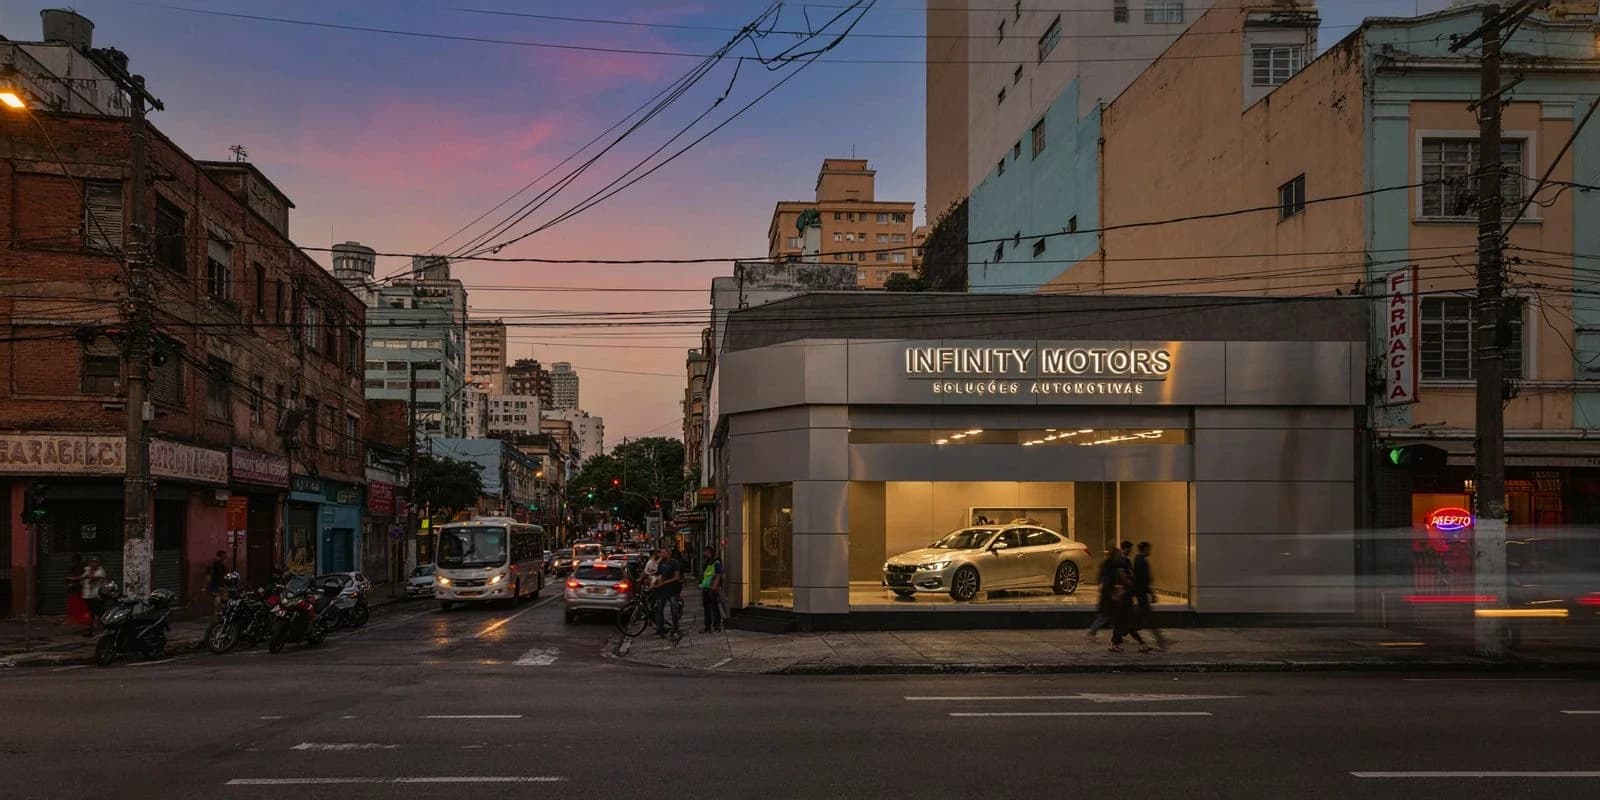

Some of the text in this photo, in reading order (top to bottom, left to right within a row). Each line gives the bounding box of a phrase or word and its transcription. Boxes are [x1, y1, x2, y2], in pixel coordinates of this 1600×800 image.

[906, 348, 1171, 374] INFINITY MOTORS
[1031, 382, 1144, 394] AUTOMOTIVAS
